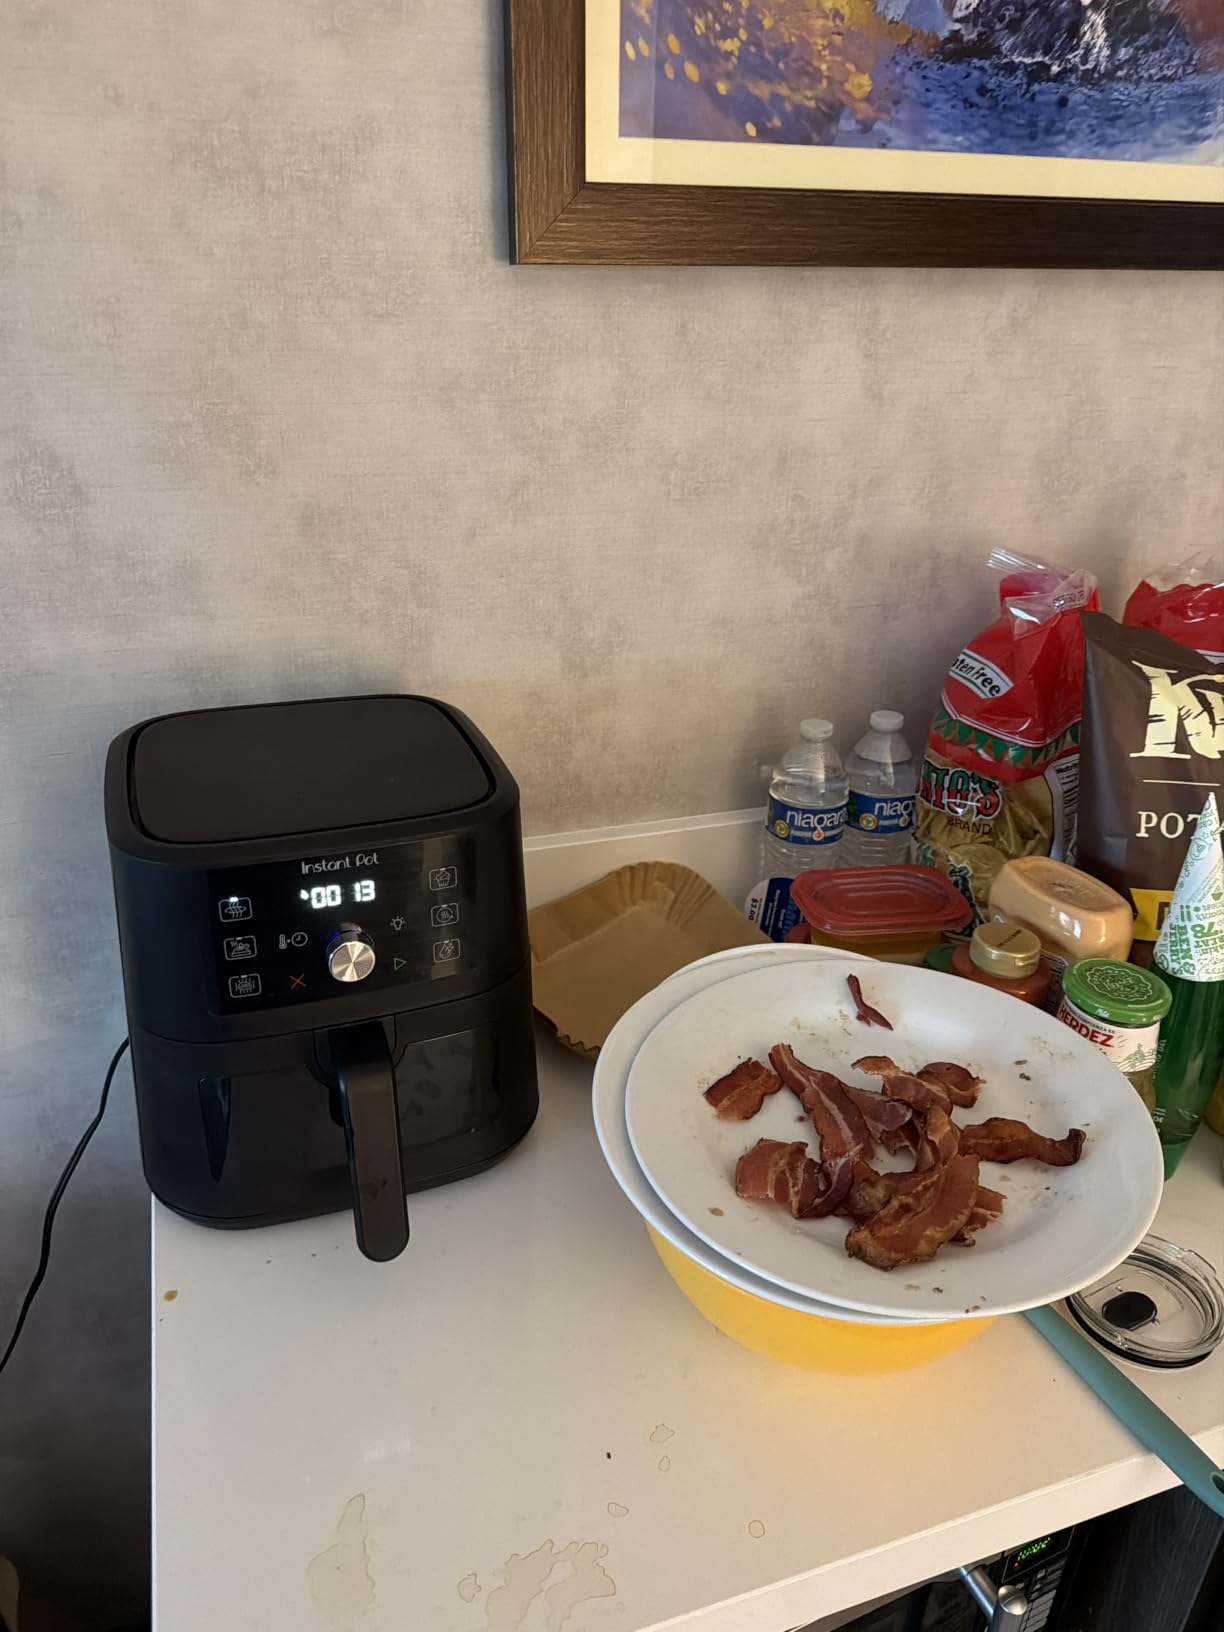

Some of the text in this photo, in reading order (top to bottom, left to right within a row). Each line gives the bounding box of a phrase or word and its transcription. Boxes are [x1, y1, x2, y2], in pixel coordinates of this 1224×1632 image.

[786, 806, 848, 833] niagar
[874, 800, 914, 822] niag
[946, 816, 993, 836] BRAND
[301, 852, 380, 875] Instant Pot
[354, 879, 376, 902] 13
[1177, 924, 1193, 960] BEN
[1058, 1004, 1115, 1048] HERDEZ
